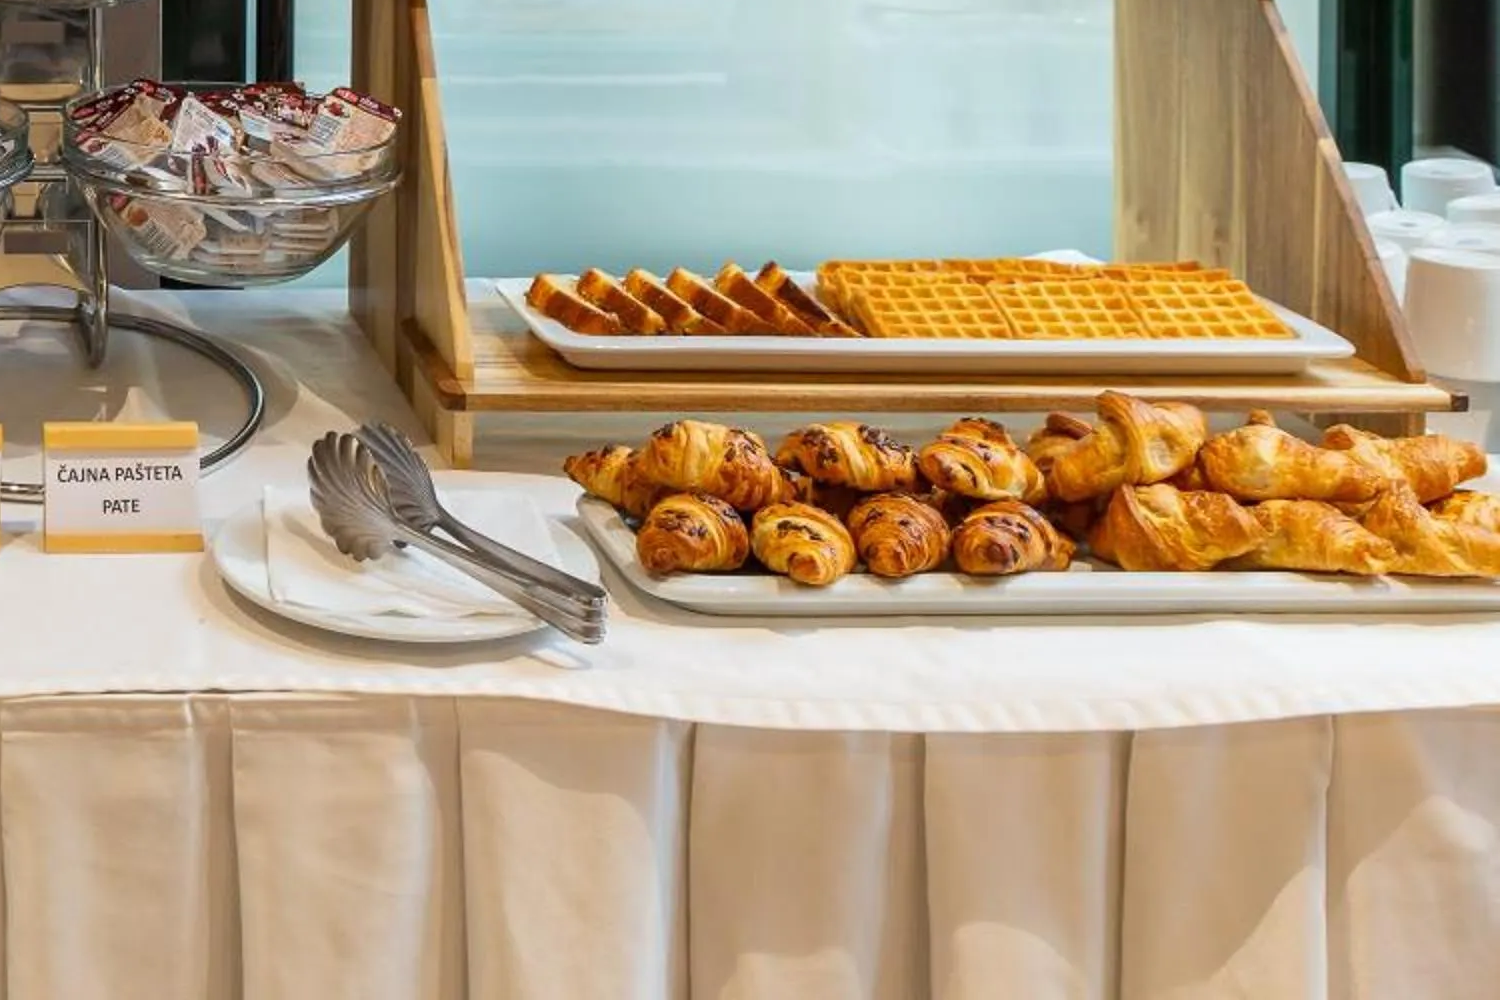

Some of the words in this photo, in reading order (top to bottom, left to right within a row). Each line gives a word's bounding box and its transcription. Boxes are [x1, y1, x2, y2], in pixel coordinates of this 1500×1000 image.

[57, 463, 111, 483] ČAJNA
[115, 463, 184, 481] PAŠTETA
[102, 499, 140, 514] PATE
